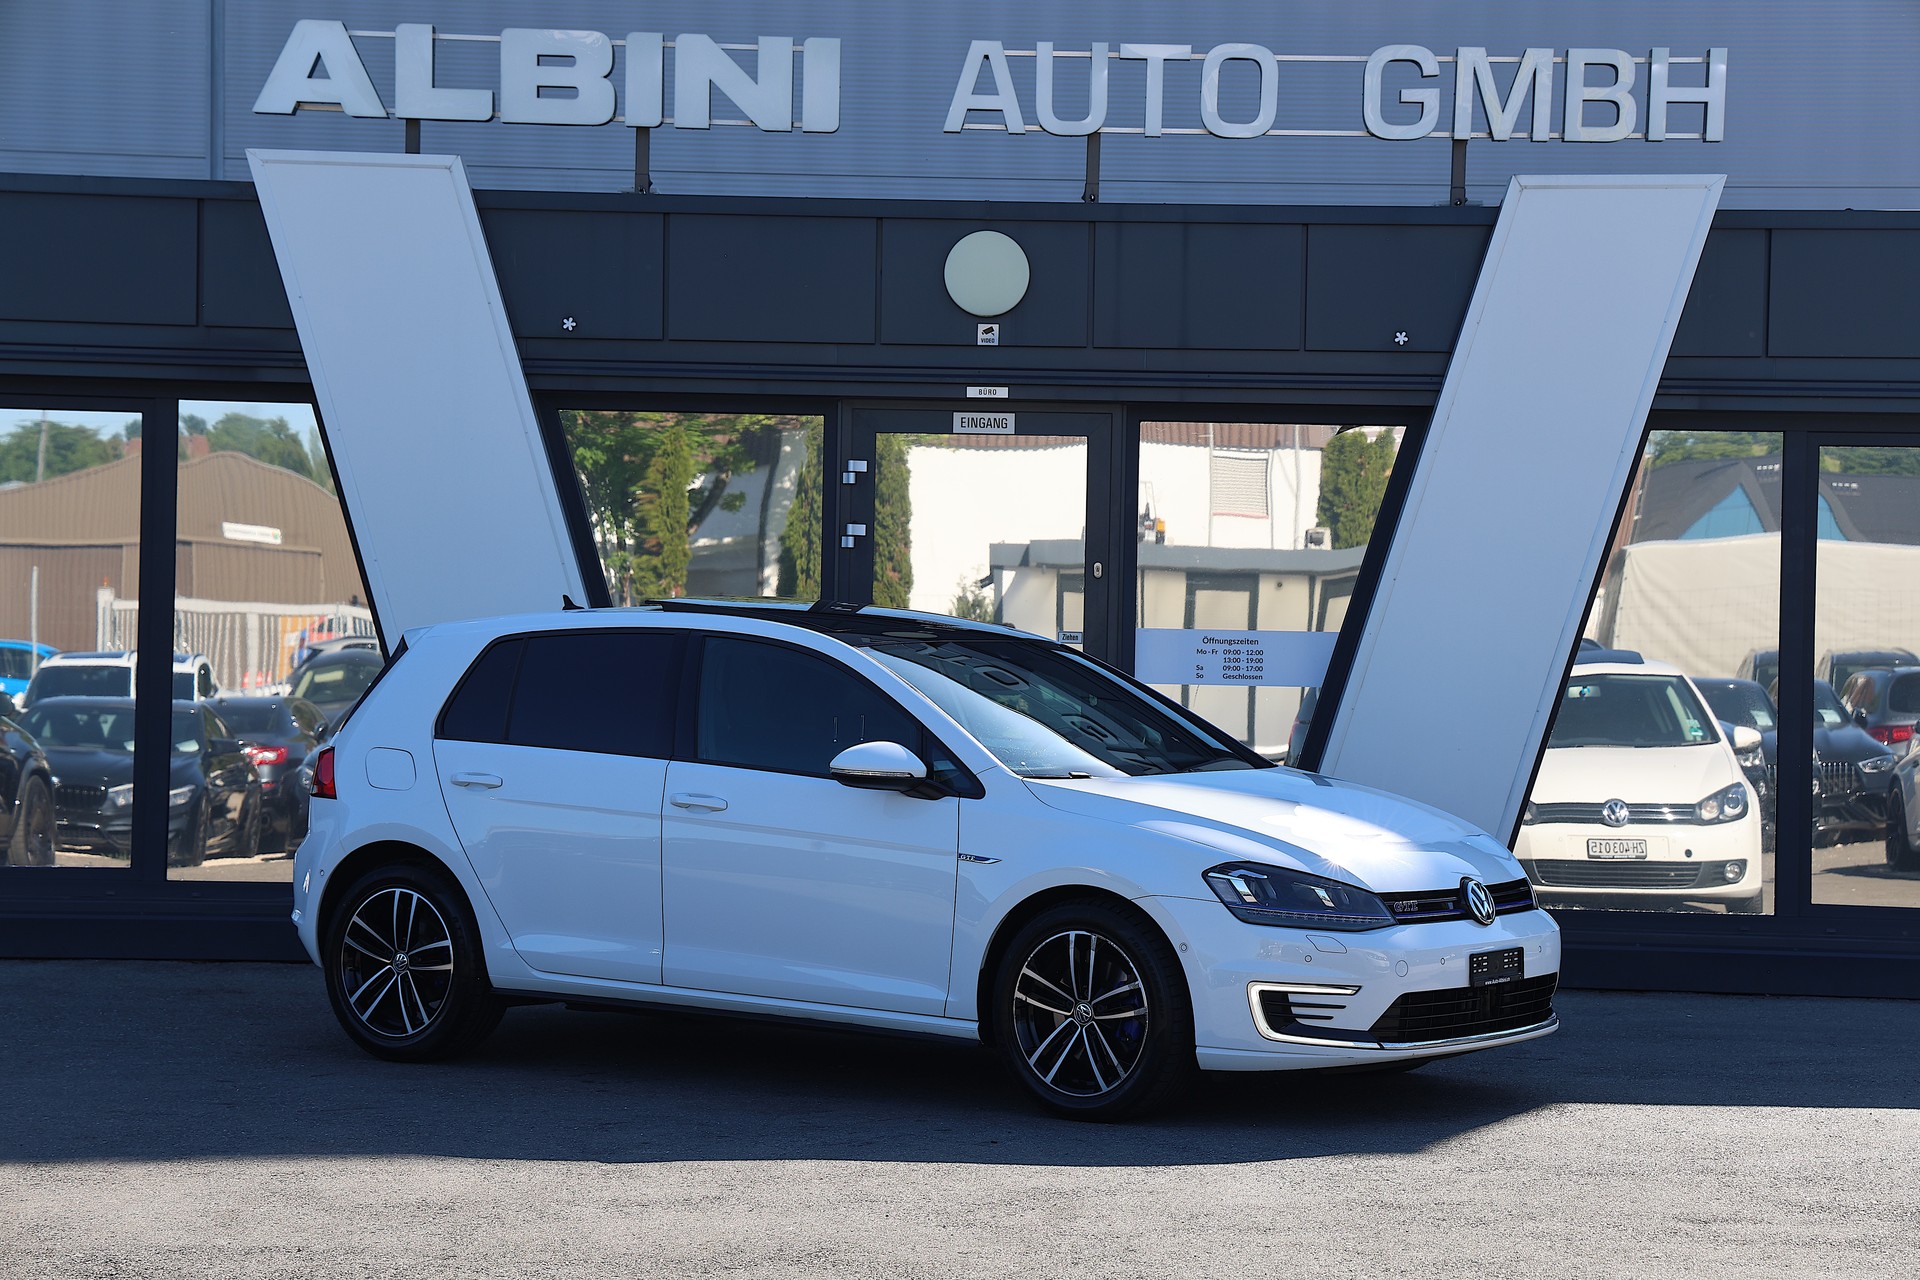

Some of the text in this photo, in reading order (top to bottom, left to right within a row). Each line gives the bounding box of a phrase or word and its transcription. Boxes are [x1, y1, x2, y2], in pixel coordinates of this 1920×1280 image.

[253, 19, 1728, 143] ALBINI AUTO GMBH
[978, 388, 997, 396] BÜRO
[960, 417, 1008, 429] EINGANG
[1062, 633, 1079, 641] Ziehen
[1202, 636, 1259, 646] Öffnungszeiten
[1393, 900, 1418, 912] GTE
